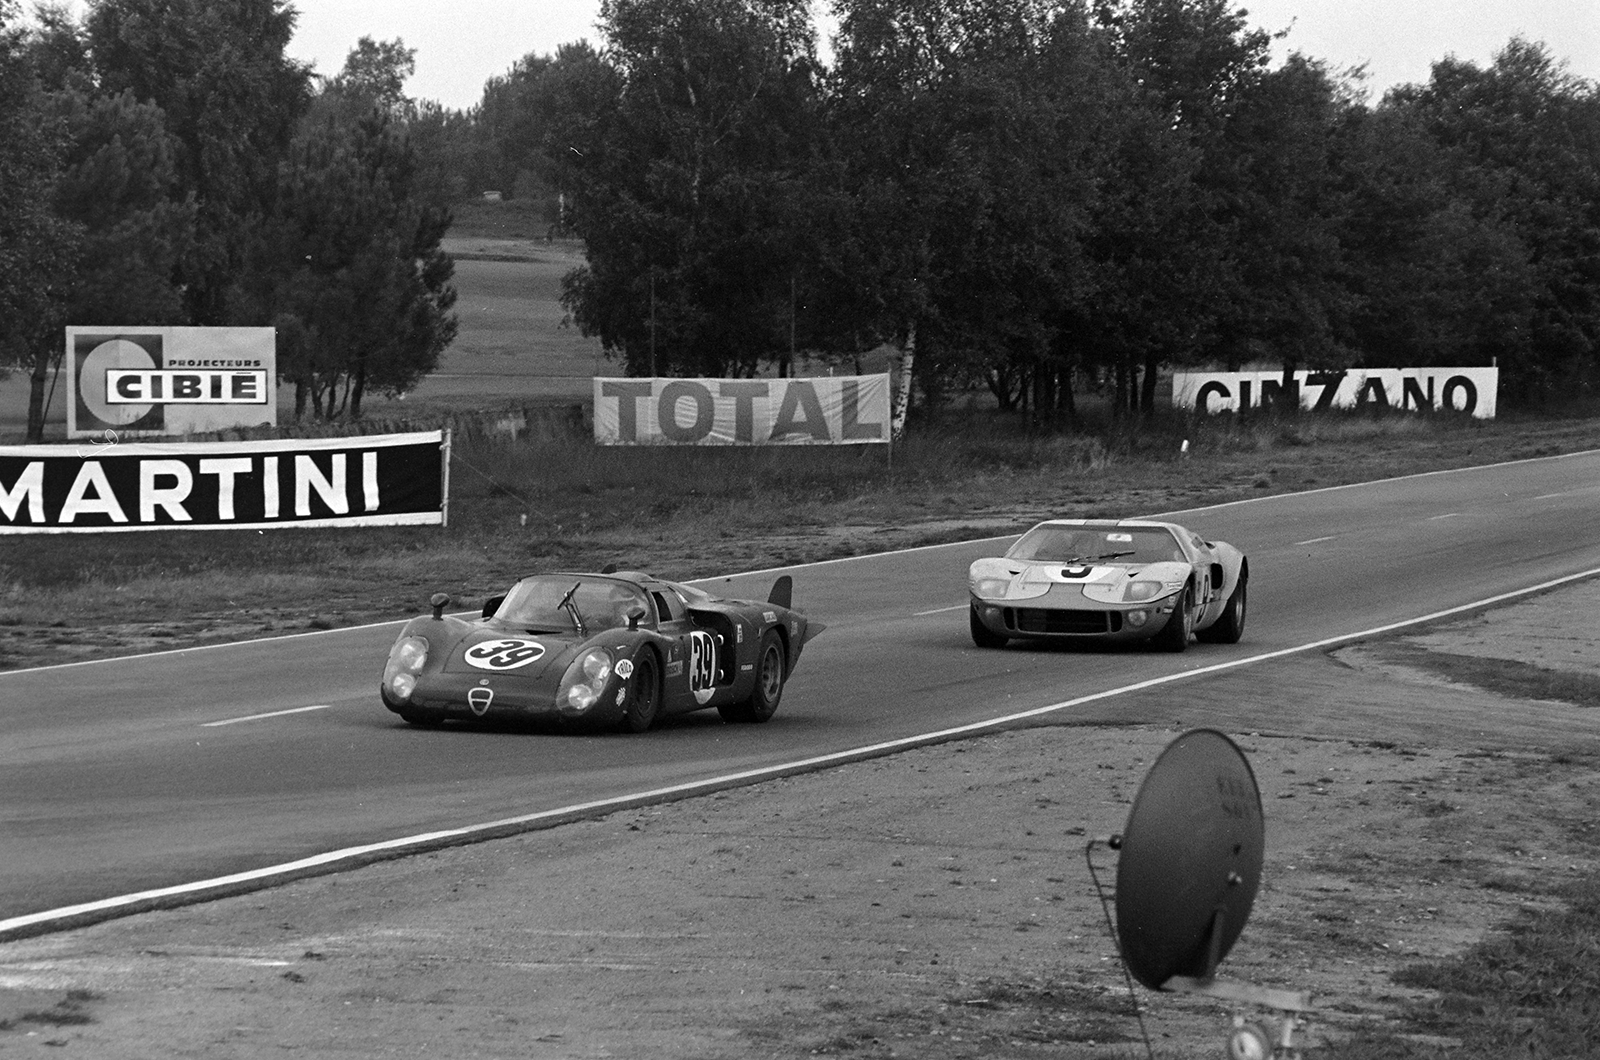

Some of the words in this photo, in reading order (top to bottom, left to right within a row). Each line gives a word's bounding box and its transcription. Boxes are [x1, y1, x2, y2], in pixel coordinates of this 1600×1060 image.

[168, 359, 261, 367] PROJECTEURS
[601, 380, 882, 442] TOTAL
[0, 451, 380, 523] MARTINI
[469, 641, 544, 668] 39
[691, 632, 713, 692] 39
